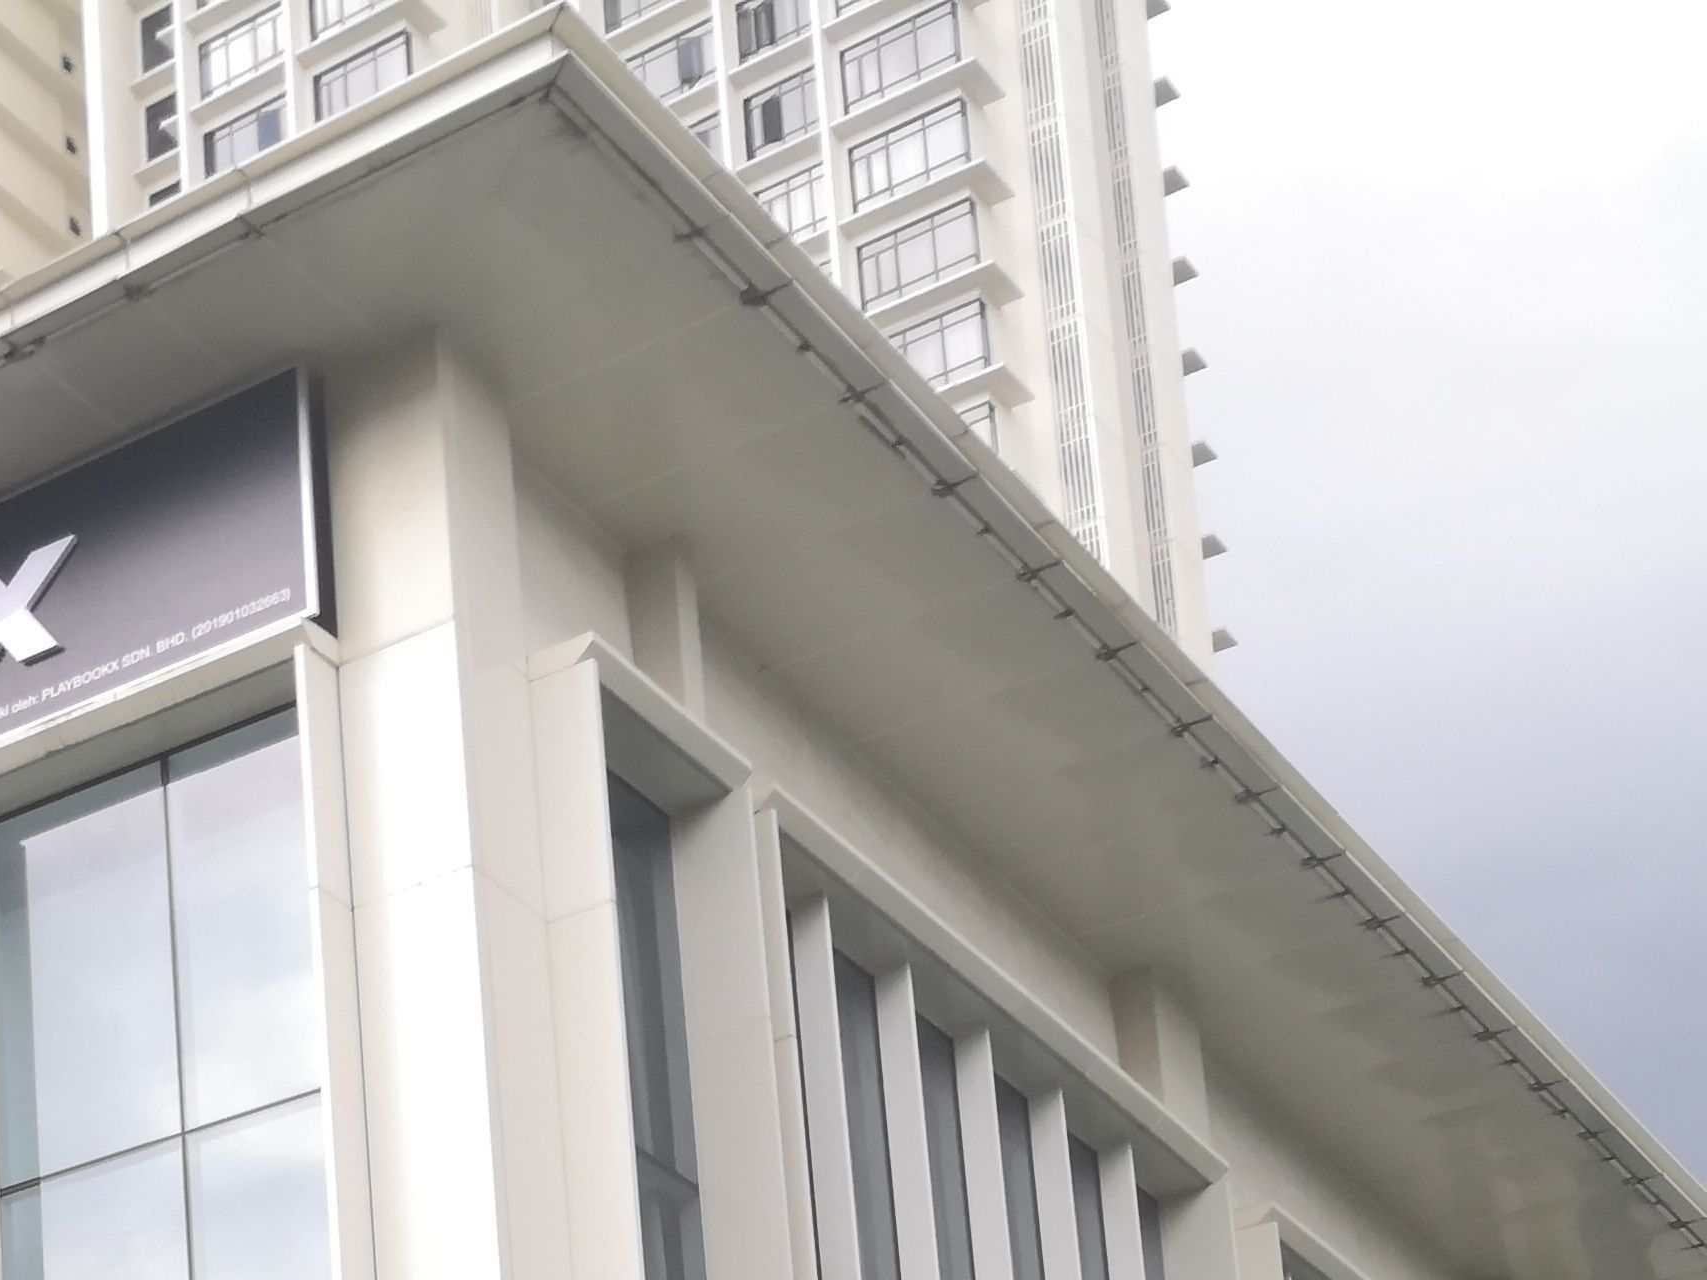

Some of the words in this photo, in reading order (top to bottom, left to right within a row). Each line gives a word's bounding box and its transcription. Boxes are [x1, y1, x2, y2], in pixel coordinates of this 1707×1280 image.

[41, 662, 119, 702] PLAYBOOKX
[121, 647, 153, 671] SDN.
[156, 632, 189, 654] BHD.
